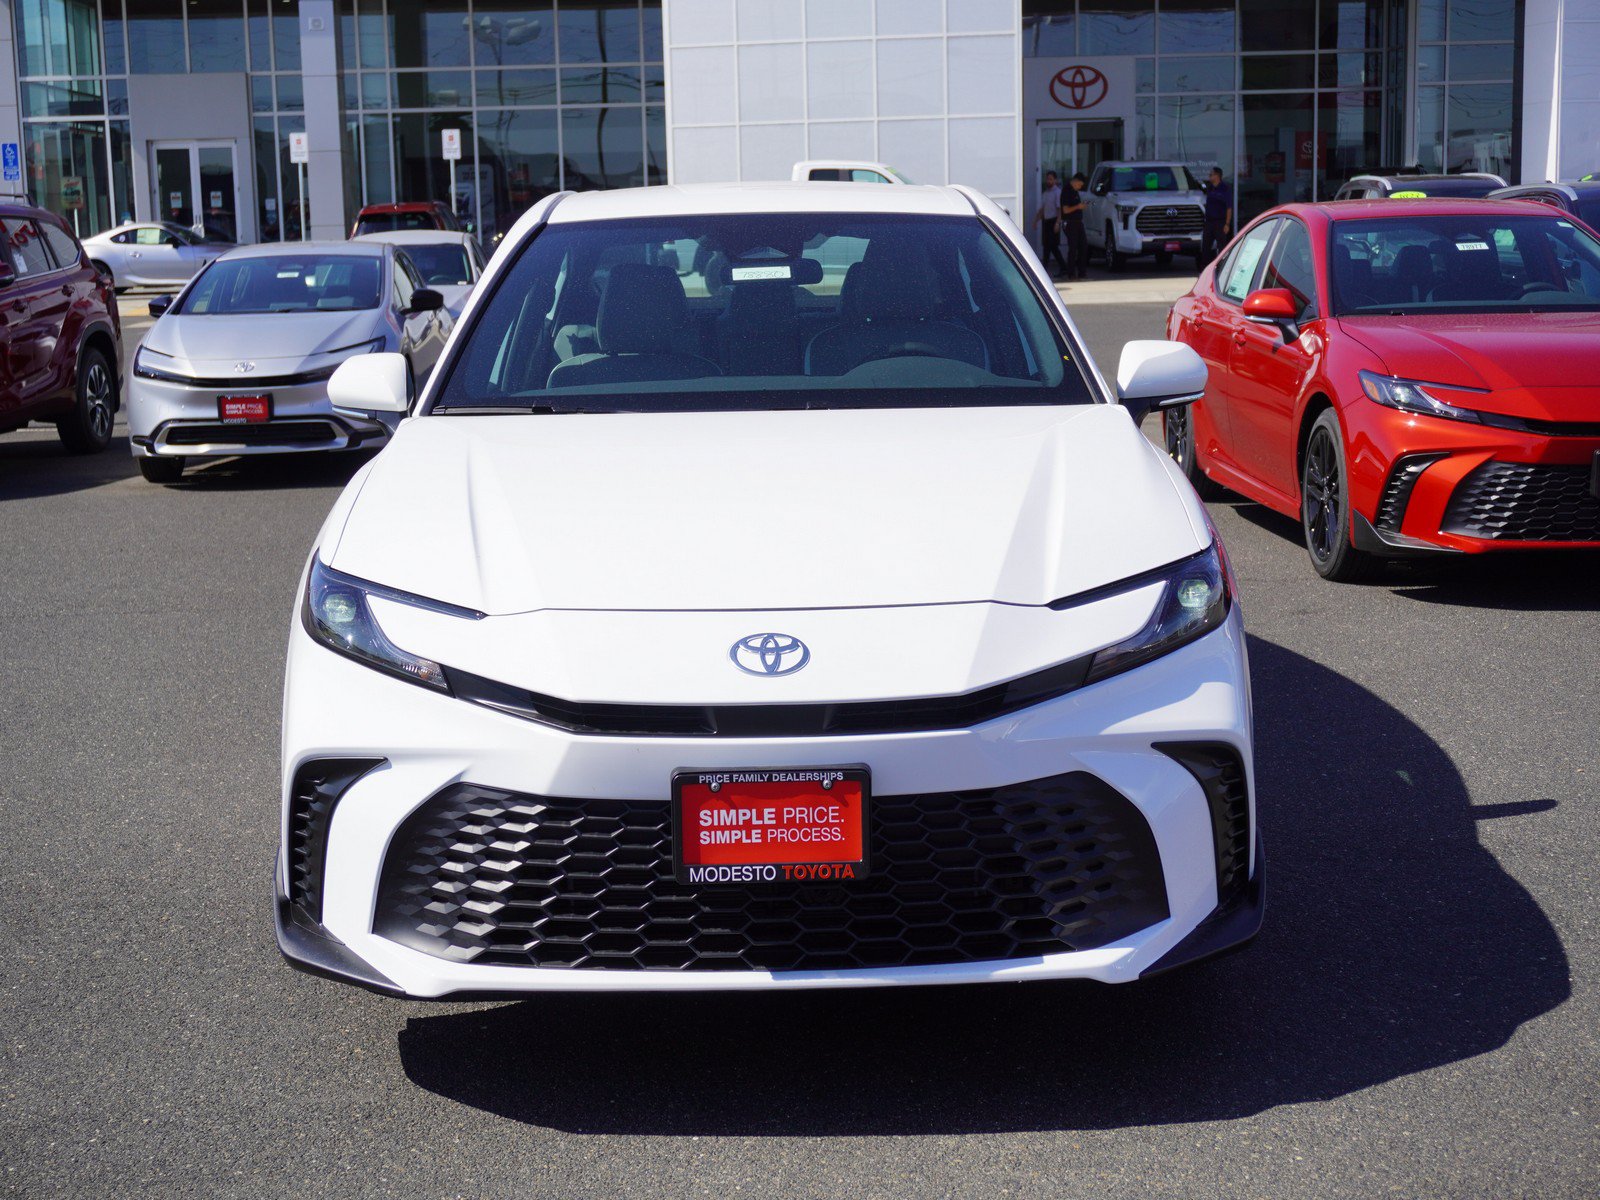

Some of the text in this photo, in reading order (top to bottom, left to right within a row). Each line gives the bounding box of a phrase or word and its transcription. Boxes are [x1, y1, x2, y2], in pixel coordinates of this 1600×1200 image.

[699, 772, 844, 783] PRICE FAMILY DEALERSHIPS
[699, 806, 845, 827] SIMPLE PRICE.
[699, 827, 845, 845] SIMPLE PROCESS.
[689, 864, 855, 883] MODESTO TOYOTA
